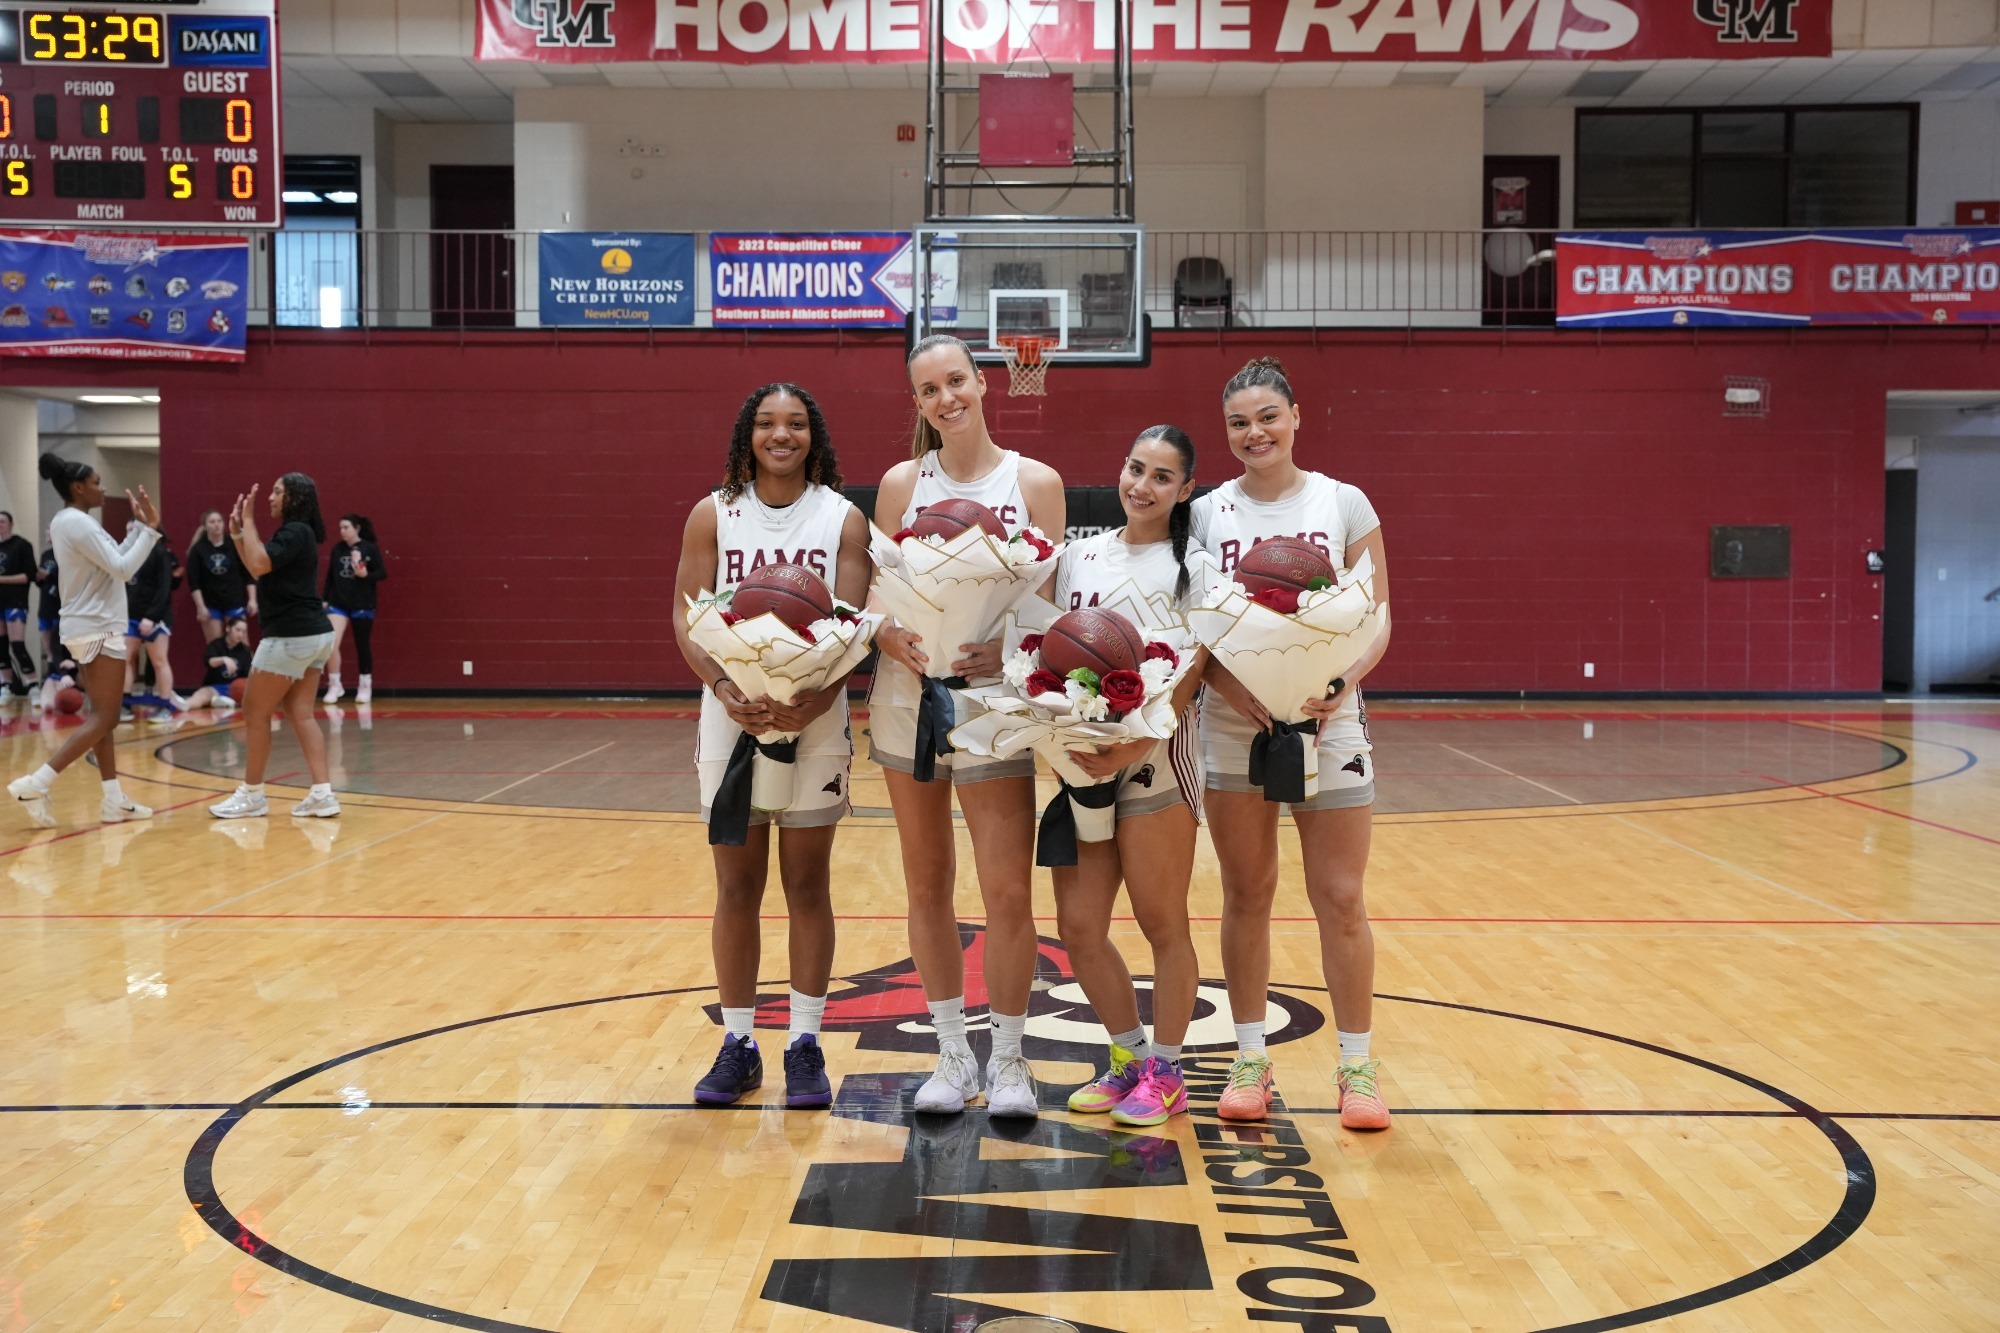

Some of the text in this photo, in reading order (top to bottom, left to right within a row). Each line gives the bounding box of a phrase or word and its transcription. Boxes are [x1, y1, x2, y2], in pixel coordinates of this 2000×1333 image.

[655, 0, 1640, 52] HOME OF THE RAMS
[30, 14, 160, 60] 53:29
[182, 29, 257, 54] DASANI
[64, 81, 115, 97] PERIOD
[183, 71, 249, 94] GUEST
[100, 103, 109, 134] 1
[226, 99, 252, 143] 0
[50, 145, 147, 162] PLAYER FOUL
[161, 147, 199, 162] T.O.L.
[214, 148, 258, 163] FOULS
[7, 161, 29, 196] 5
[169, 163, 192, 199] 5
[231, 165, 253, 199] 0
[77, 204, 124, 220] MATCH
[224, 206, 256, 221] WON
[592, 238, 629, 247] Sponsored
[738, 239, 861, 252] 2023 Competitive Cheer
[550, 277, 684, 291] NEW HORIZONS
[717, 261, 863, 298] CHAMPIONS
[1573, 264, 1794, 294] CHAMPIONS
[556, 293, 678, 303] CREDIT UNION
[585, 308, 649, 321] NewHCU.org
[716, 308, 885, 319] Southern States Athletic Conference
[1220, 532, 1330, 573] RS
